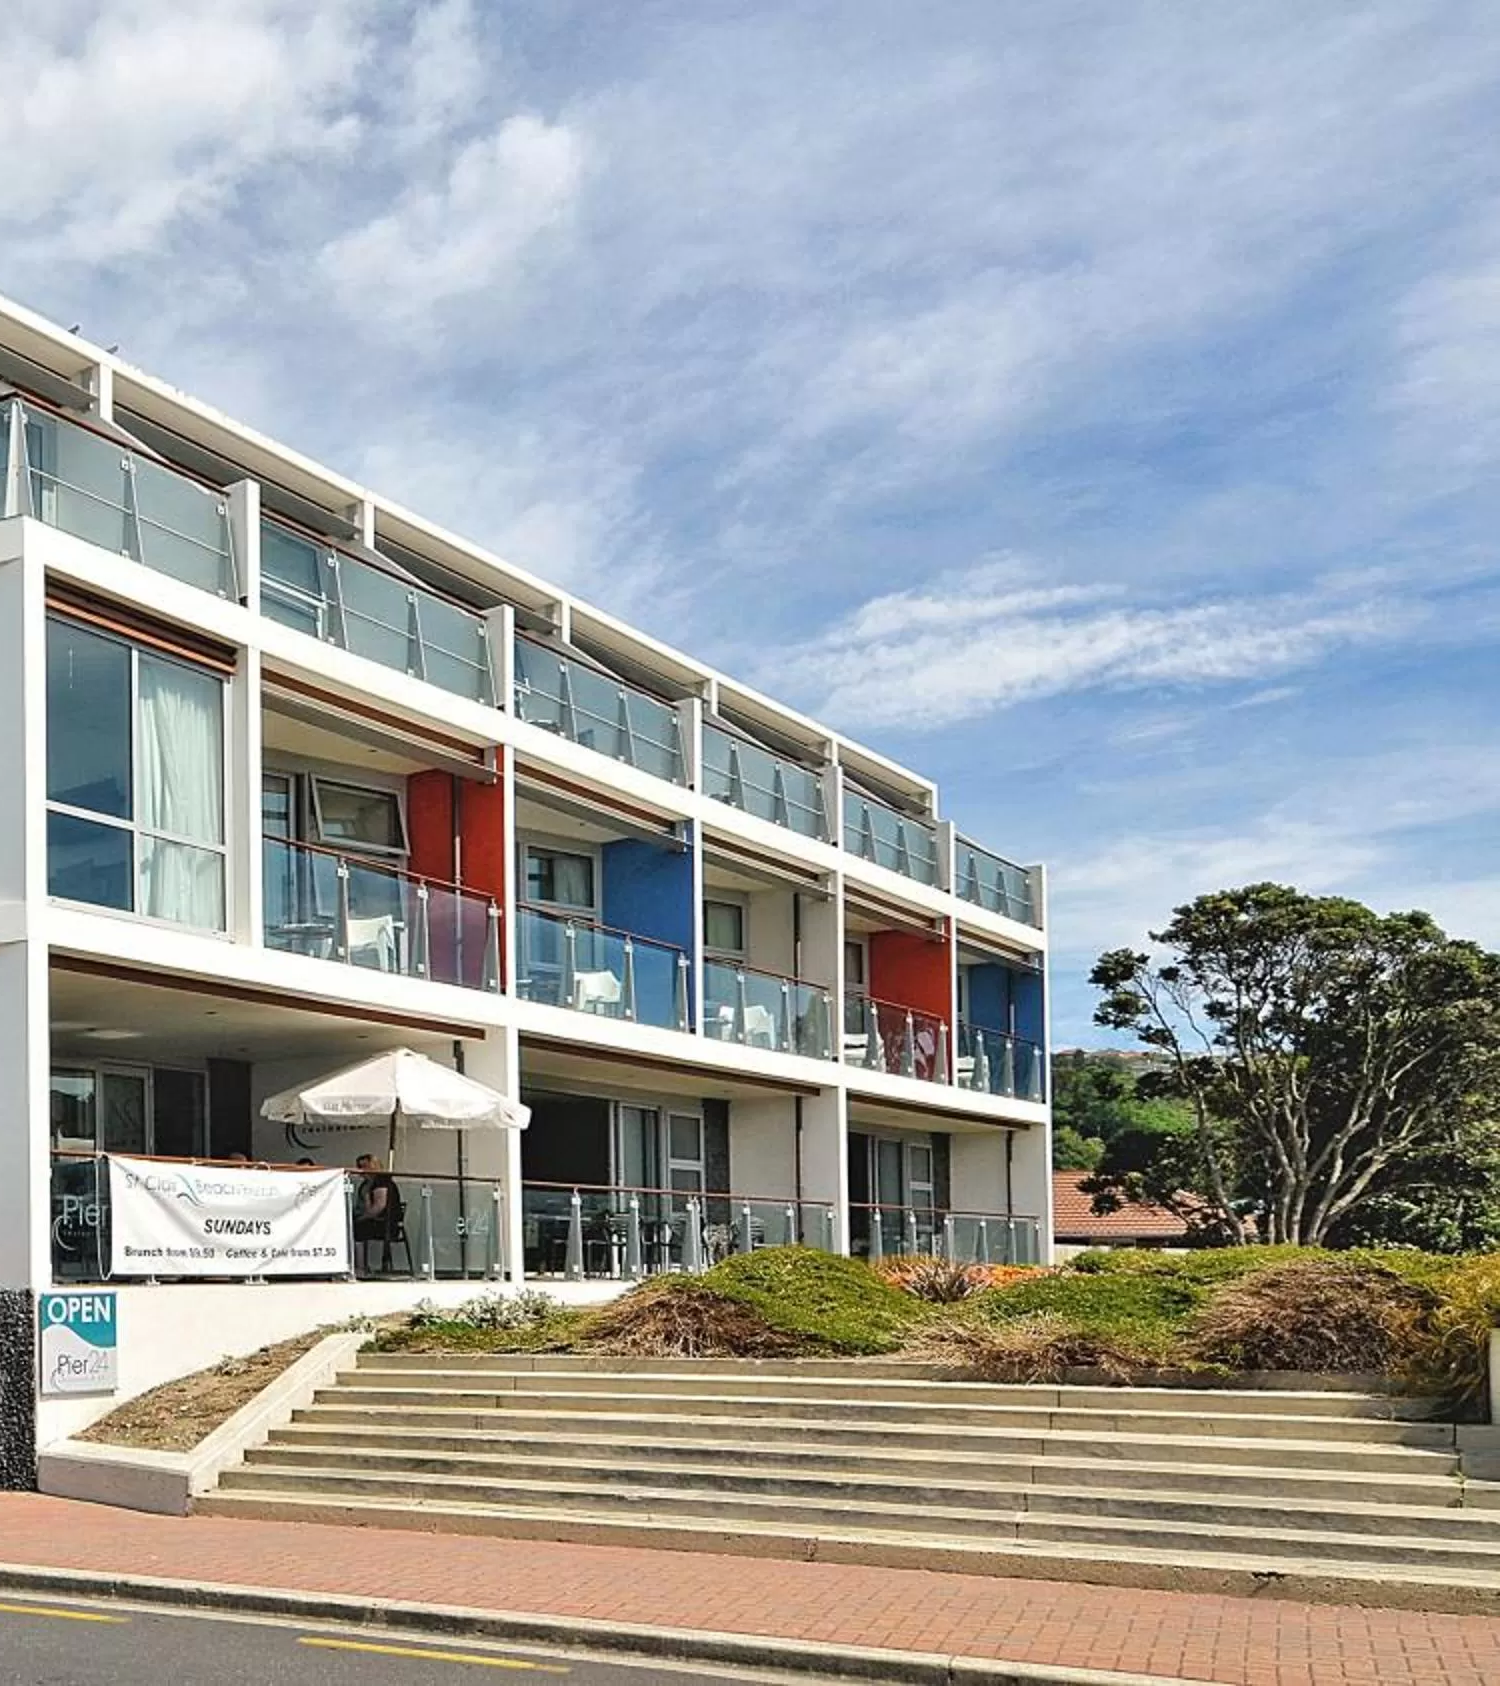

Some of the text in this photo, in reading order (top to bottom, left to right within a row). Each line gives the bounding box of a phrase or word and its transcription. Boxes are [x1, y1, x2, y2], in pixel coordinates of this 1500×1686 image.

[63, 1194, 109, 1227] Pier
[203, 1218, 272, 1235] SUNDAYS
[124, 1246, 163, 1257] Brunch
[225, 1247, 257, 1259] Coffee
[260, 1248, 268, 1258] &
[47, 1296, 111, 1323] OPEN
[57, 1349, 109, 1374] Pier24
